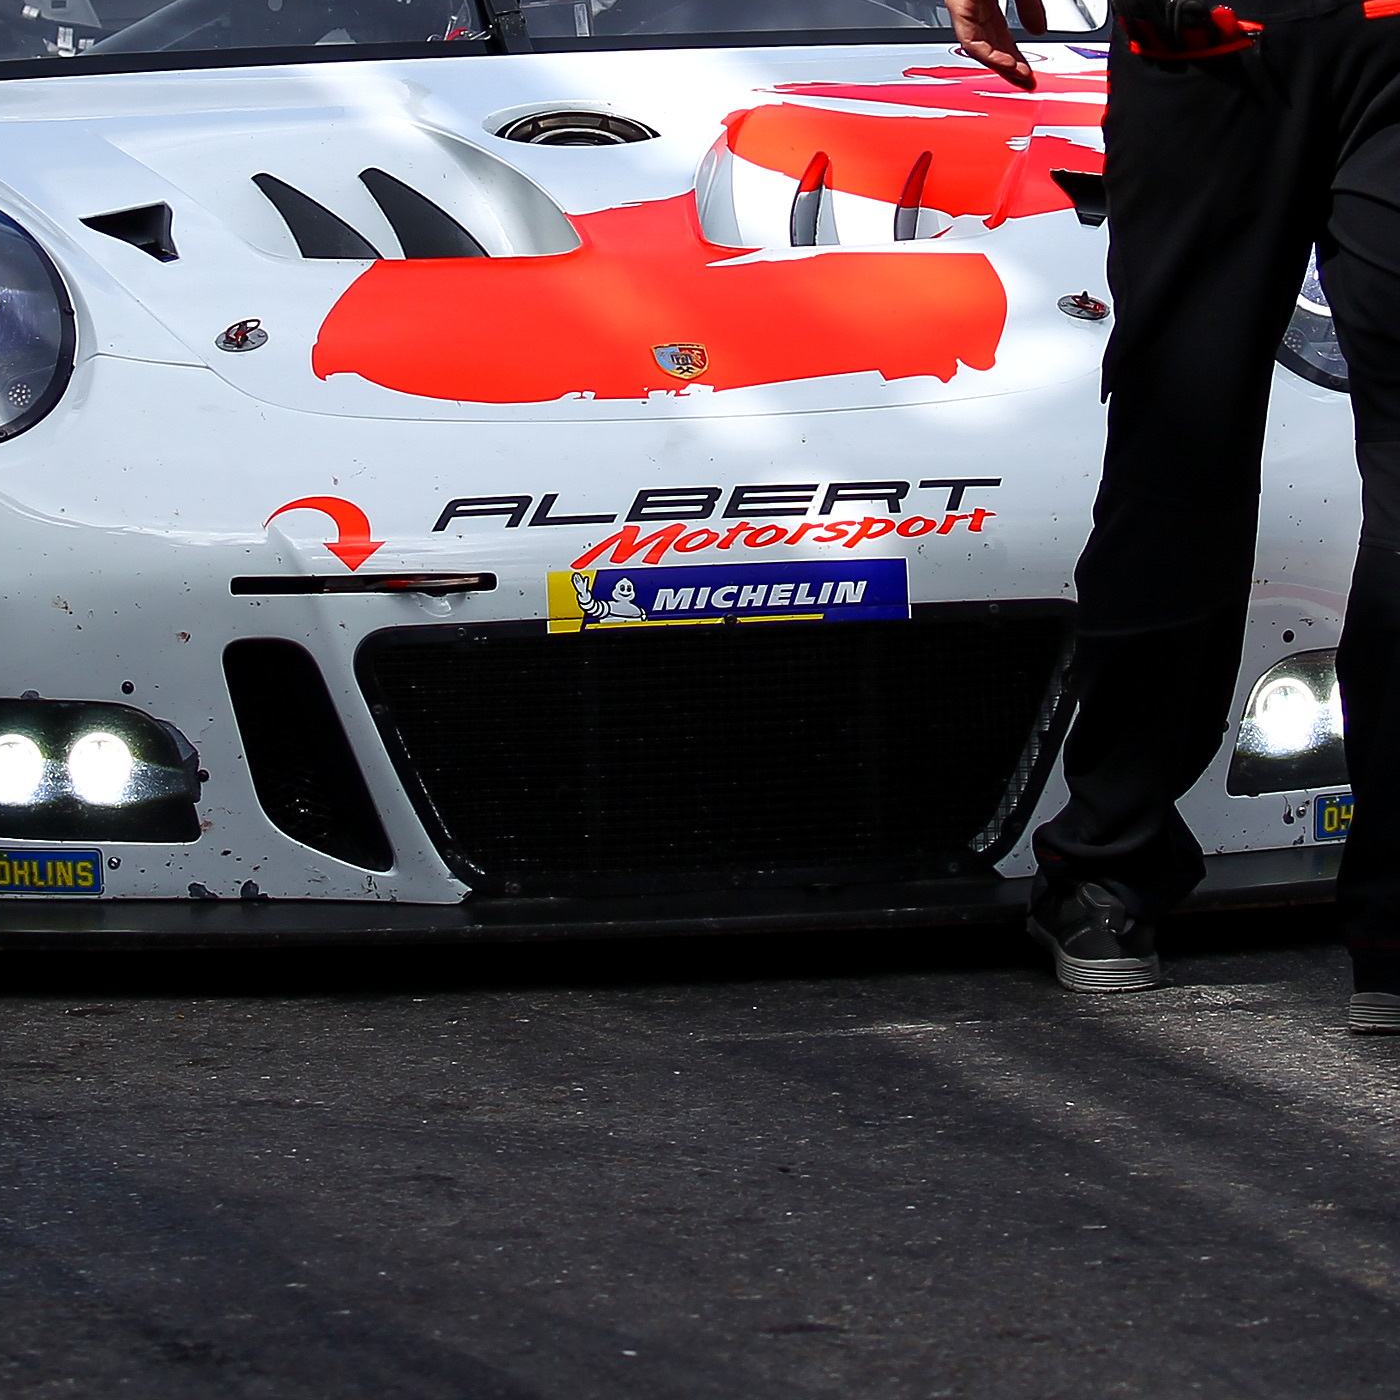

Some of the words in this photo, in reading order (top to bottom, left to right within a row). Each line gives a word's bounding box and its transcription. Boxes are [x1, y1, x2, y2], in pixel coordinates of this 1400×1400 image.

[432, 477, 1003, 533] ALBERT
[570, 506, 997, 570] Motorsport
[652, 580, 867, 613] MICHELIN
